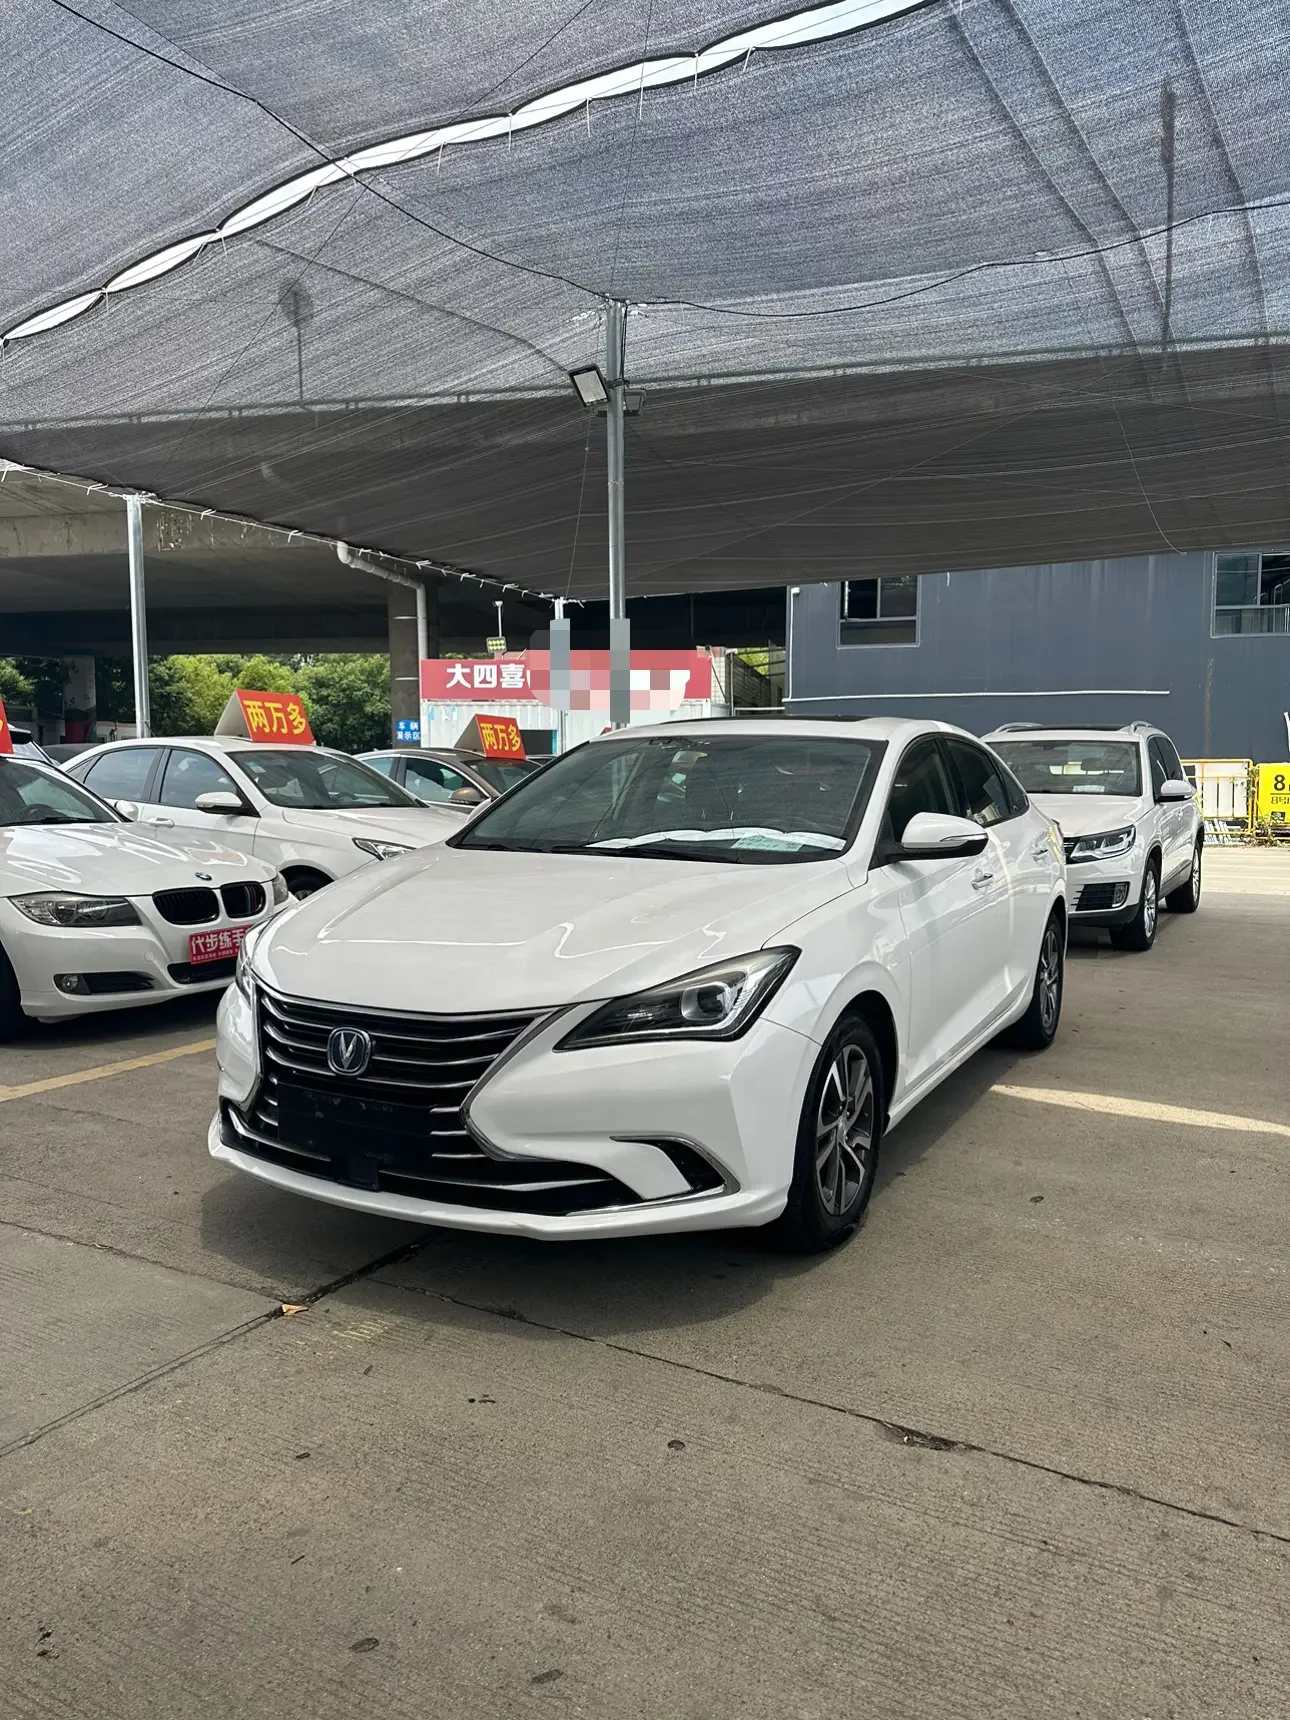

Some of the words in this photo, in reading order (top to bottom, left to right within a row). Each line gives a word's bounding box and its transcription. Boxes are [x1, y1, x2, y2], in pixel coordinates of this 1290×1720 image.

[446, 663, 531, 688] 大四喜
[242, 700, 306, 735] 两万多
[398, 721, 419, 730] 车辆
[397, 731, 421, 740] 展示区
[479, 723, 521, 751] 两万多
[1273, 774, 1290, 791] 8
[191, 928, 246, 955] 代步练手
